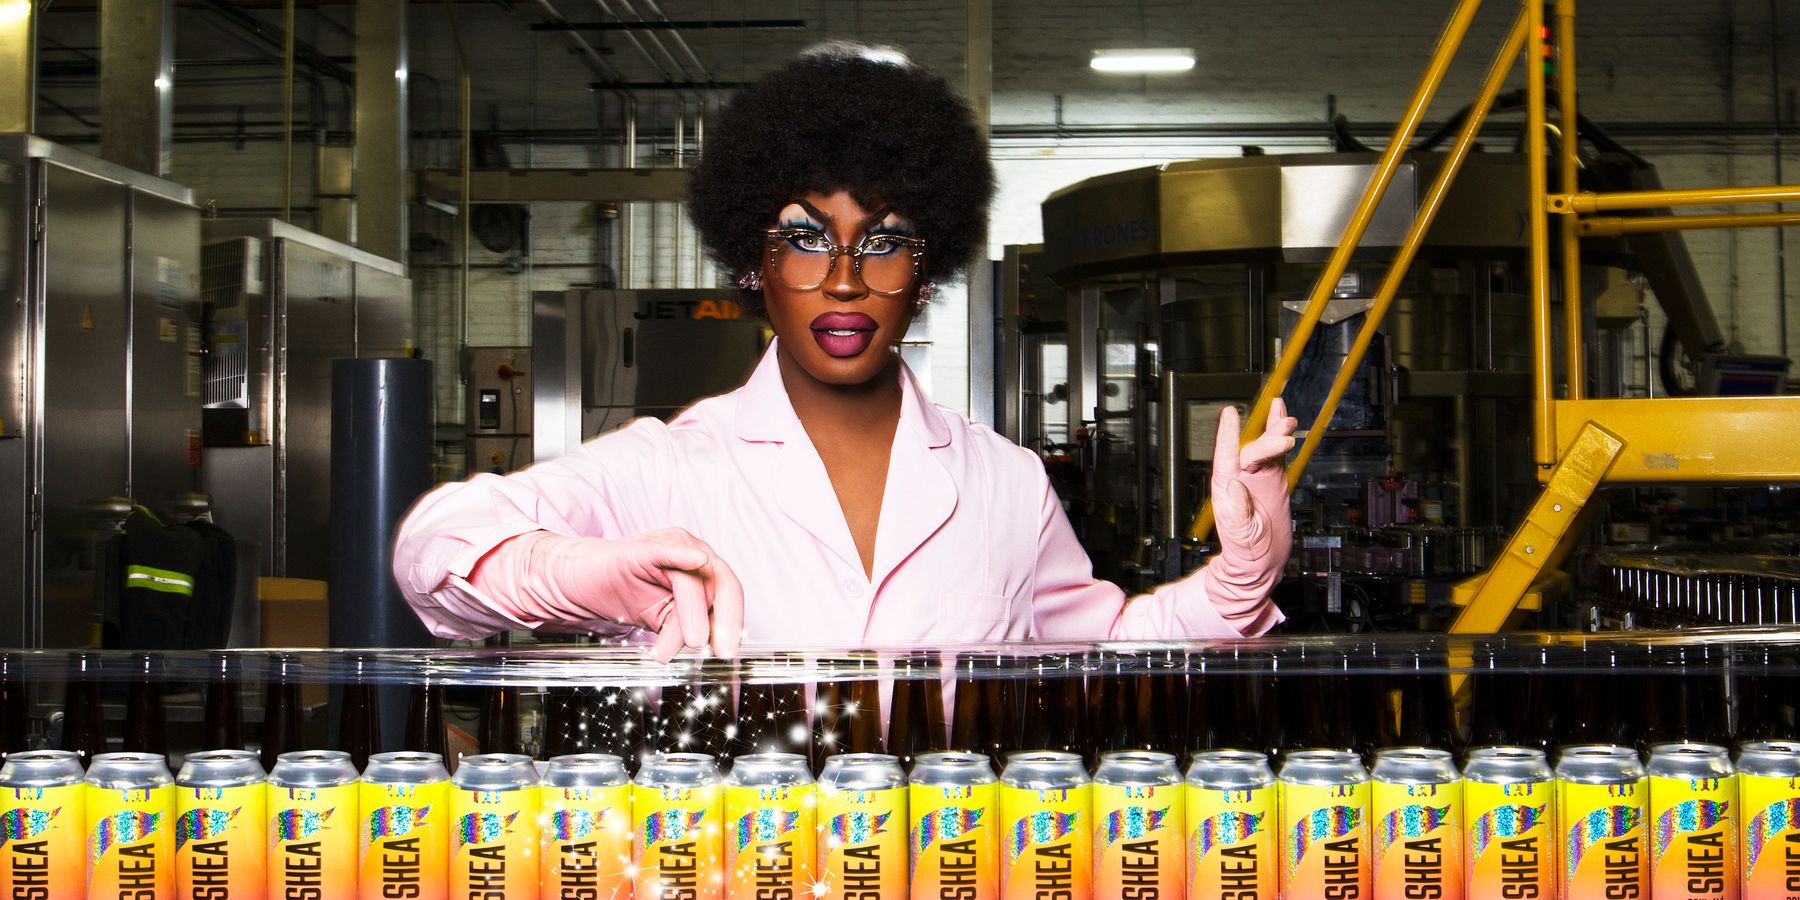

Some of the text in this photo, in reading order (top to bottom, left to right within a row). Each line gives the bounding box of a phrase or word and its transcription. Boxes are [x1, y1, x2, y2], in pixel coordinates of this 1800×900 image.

[12, 841, 48, 900] SHEA
[192, 841, 228, 900] SHEA
[285, 841, 321, 900] SHEA
[383, 838, 420, 899] SHEA
[561, 842, 597, 900] SHEA
[940, 839, 977, 900] SHEA
[1121, 840, 1159, 900] SHEA
[1324, 838, 1359, 900] SHEA
[1404, 838, 1442, 899] SHEA
[1501, 837, 1538, 899] SHEA
[1605, 837, 1639, 900] SHEA
[1687, 832, 1724, 894] SHEA
